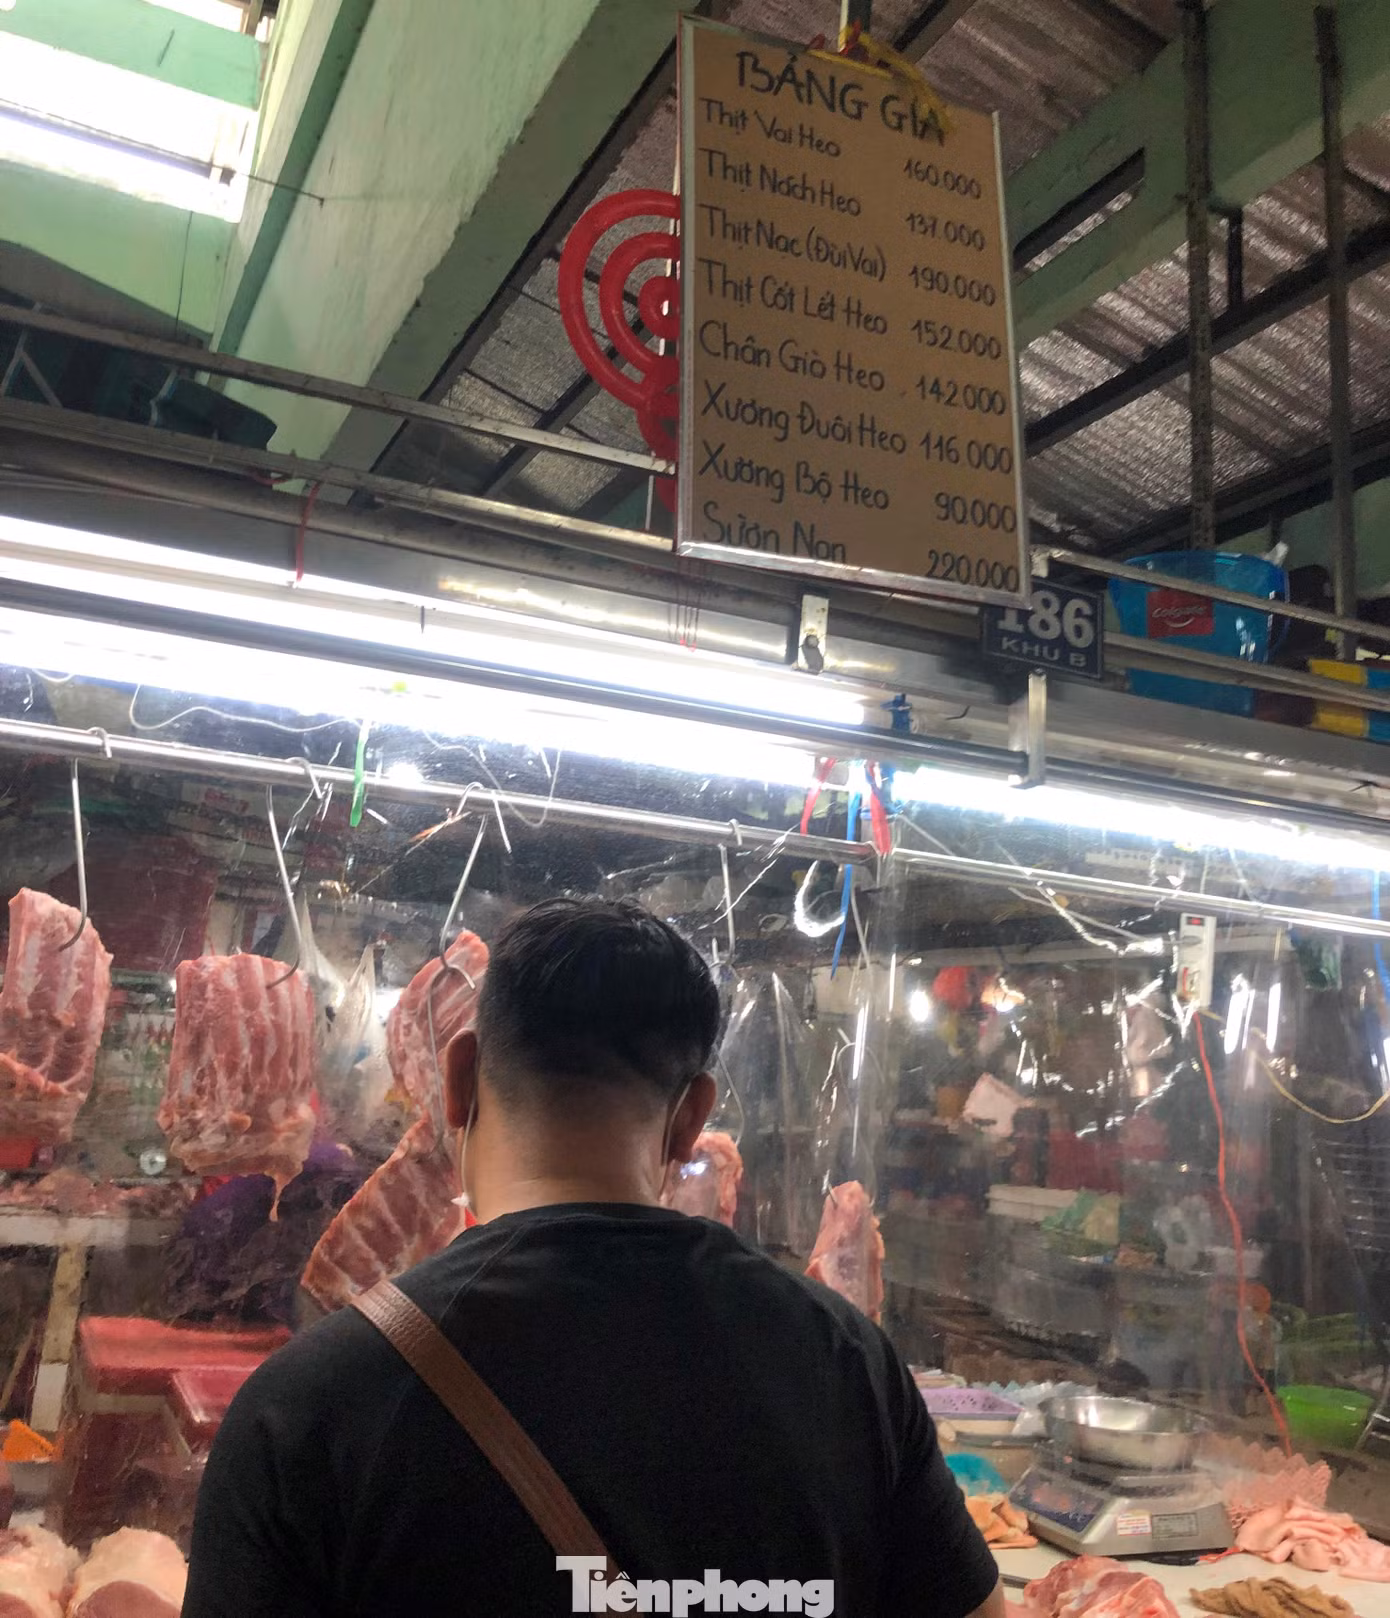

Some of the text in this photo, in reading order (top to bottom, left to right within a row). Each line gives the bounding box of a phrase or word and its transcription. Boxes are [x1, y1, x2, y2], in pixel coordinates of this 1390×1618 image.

[699, 97, 981, 199] Thịt Vai Heo 160.000
[698, 148, 986, 252] Thịt Nách Heo 137.000
[698, 203, 752, 250] Thịt
[909, 265, 996, 307] 190.000
[697, 257, 753, 308] Thịt
[842, 296, 888, 335] Heo
[910, 319, 1002, 360] 152.000
[700, 319, 771, 368] Chân
[779, 339, 827, 379] Giò
[834, 351, 885, 391] Heo
[701, 379, 790, 442] Xương
[797, 401, 852, 444] Đuôi
[858, 412, 906, 454] Heo
[699, 439, 1017, 533] Xương Bộ Heo 90.000
[793, 520, 846, 564] Non
[925, 548, 1020, 593] 220.000
[997, 590, 1095, 648] 186
[1002, 636, 1087, 668] KHU B
